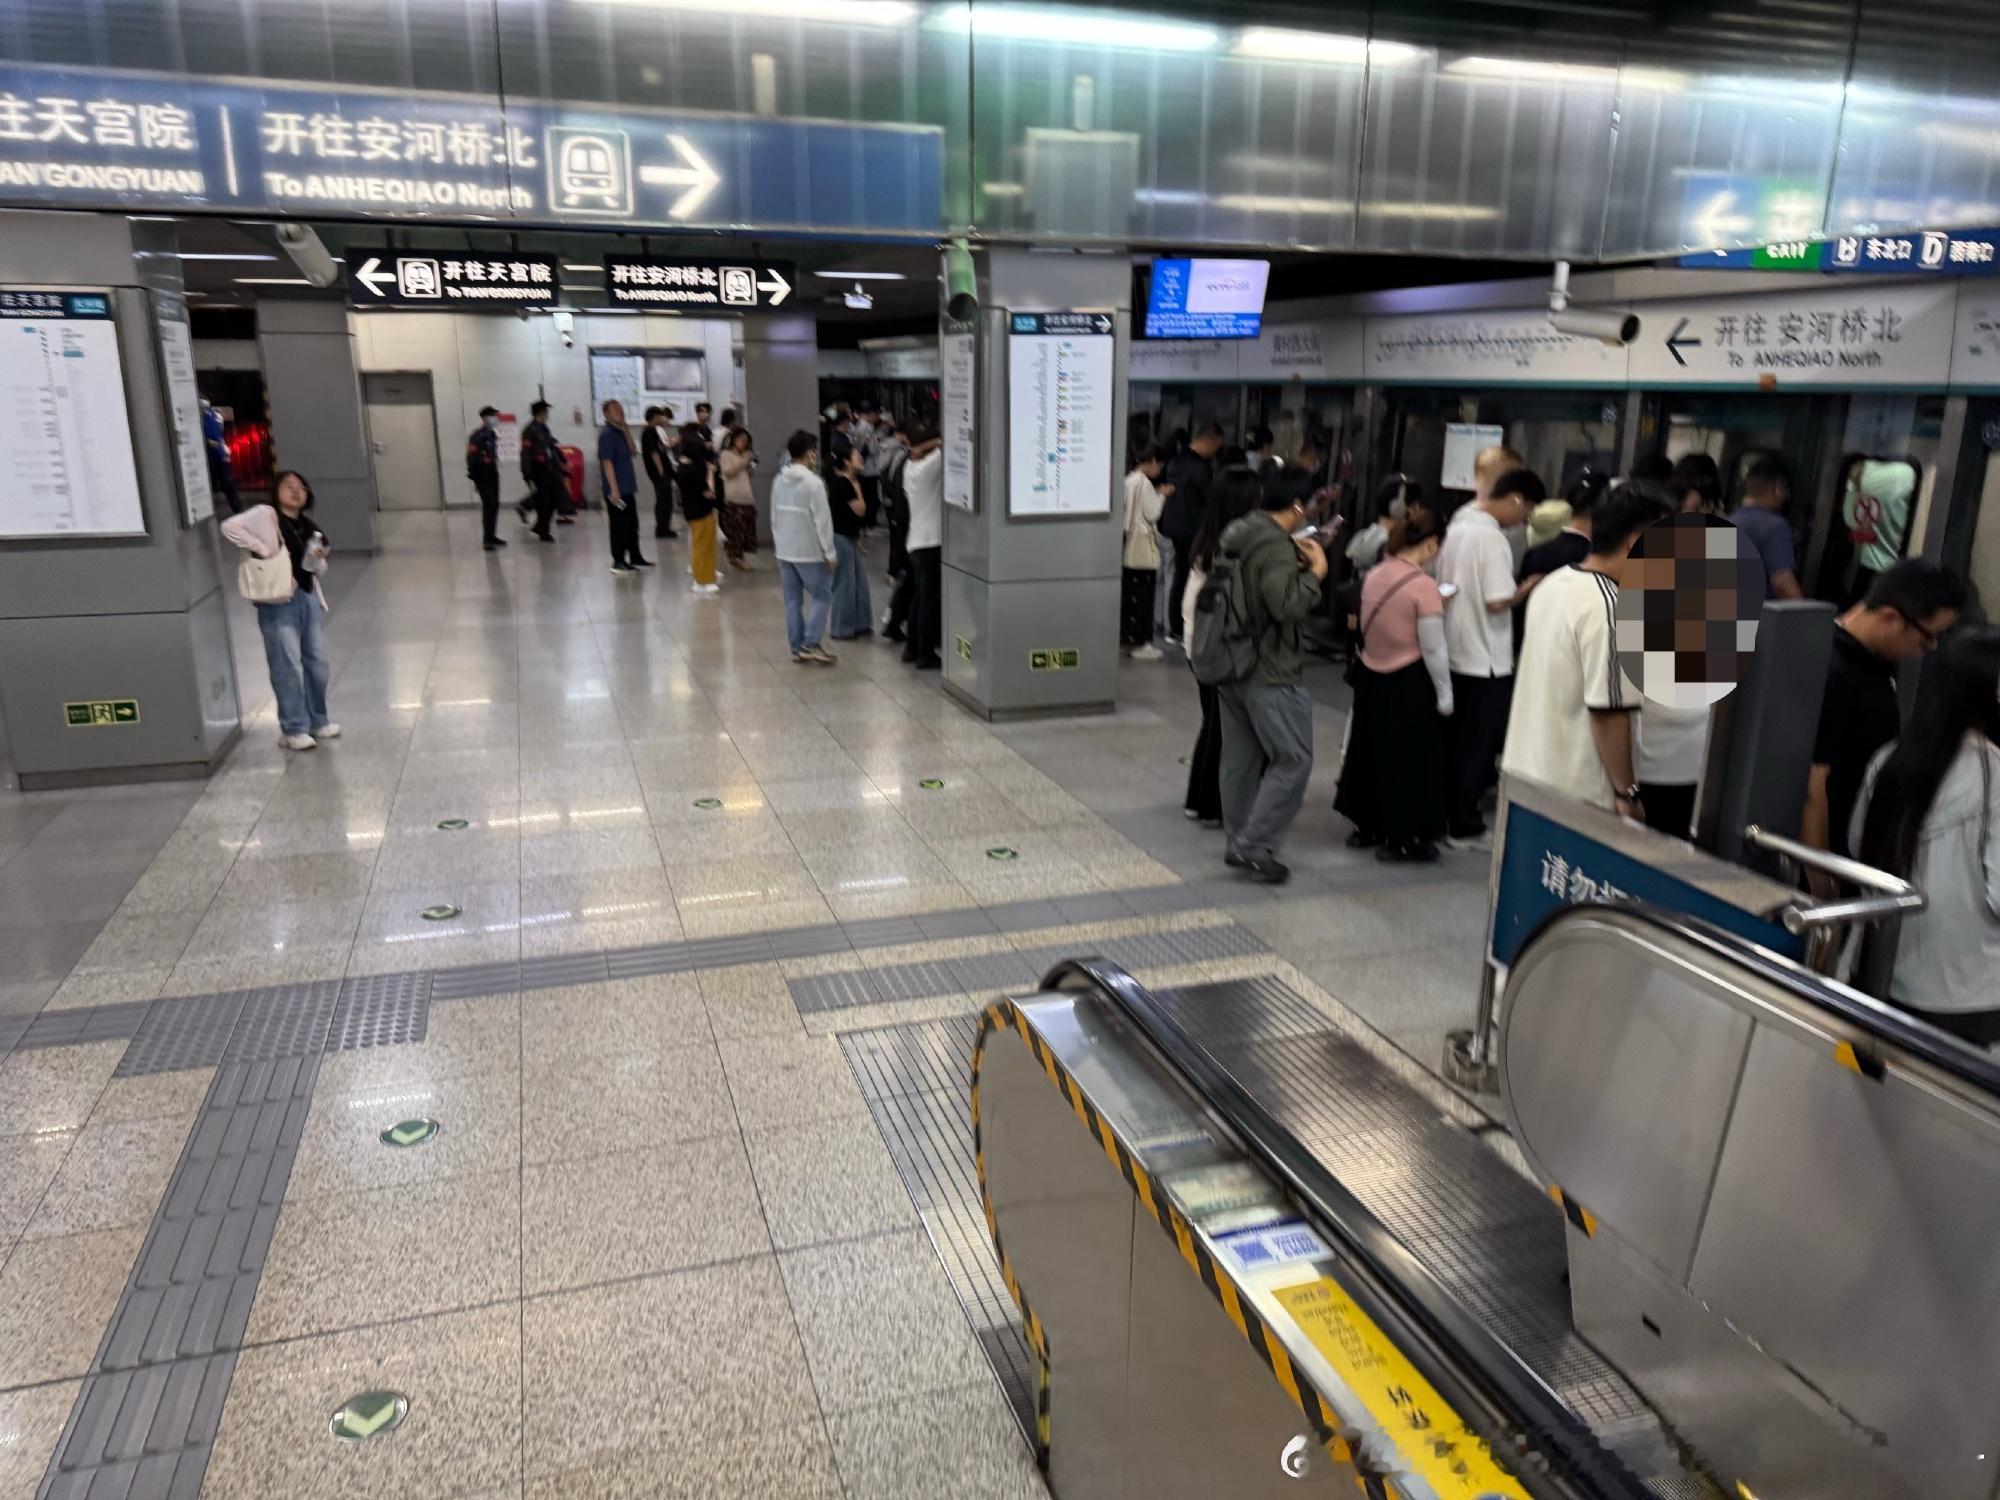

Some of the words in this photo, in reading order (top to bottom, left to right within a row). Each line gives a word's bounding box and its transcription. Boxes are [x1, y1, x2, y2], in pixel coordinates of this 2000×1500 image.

[262, 112, 537, 167] 开往安河桥北
[263, 172, 303, 198] To
[305, 175, 453, 203] ANHEQIAO
[1920, 235, 1943, 265] D
[442, 260, 552, 283] 开往天宫院
[611, 264, 719, 287] 开往安河桥北
[1715, 307, 1902, 347] 开往安河桥北
[1754, 349, 1836, 368] ANHEQIAO
[1838, 349, 1882, 367] North
